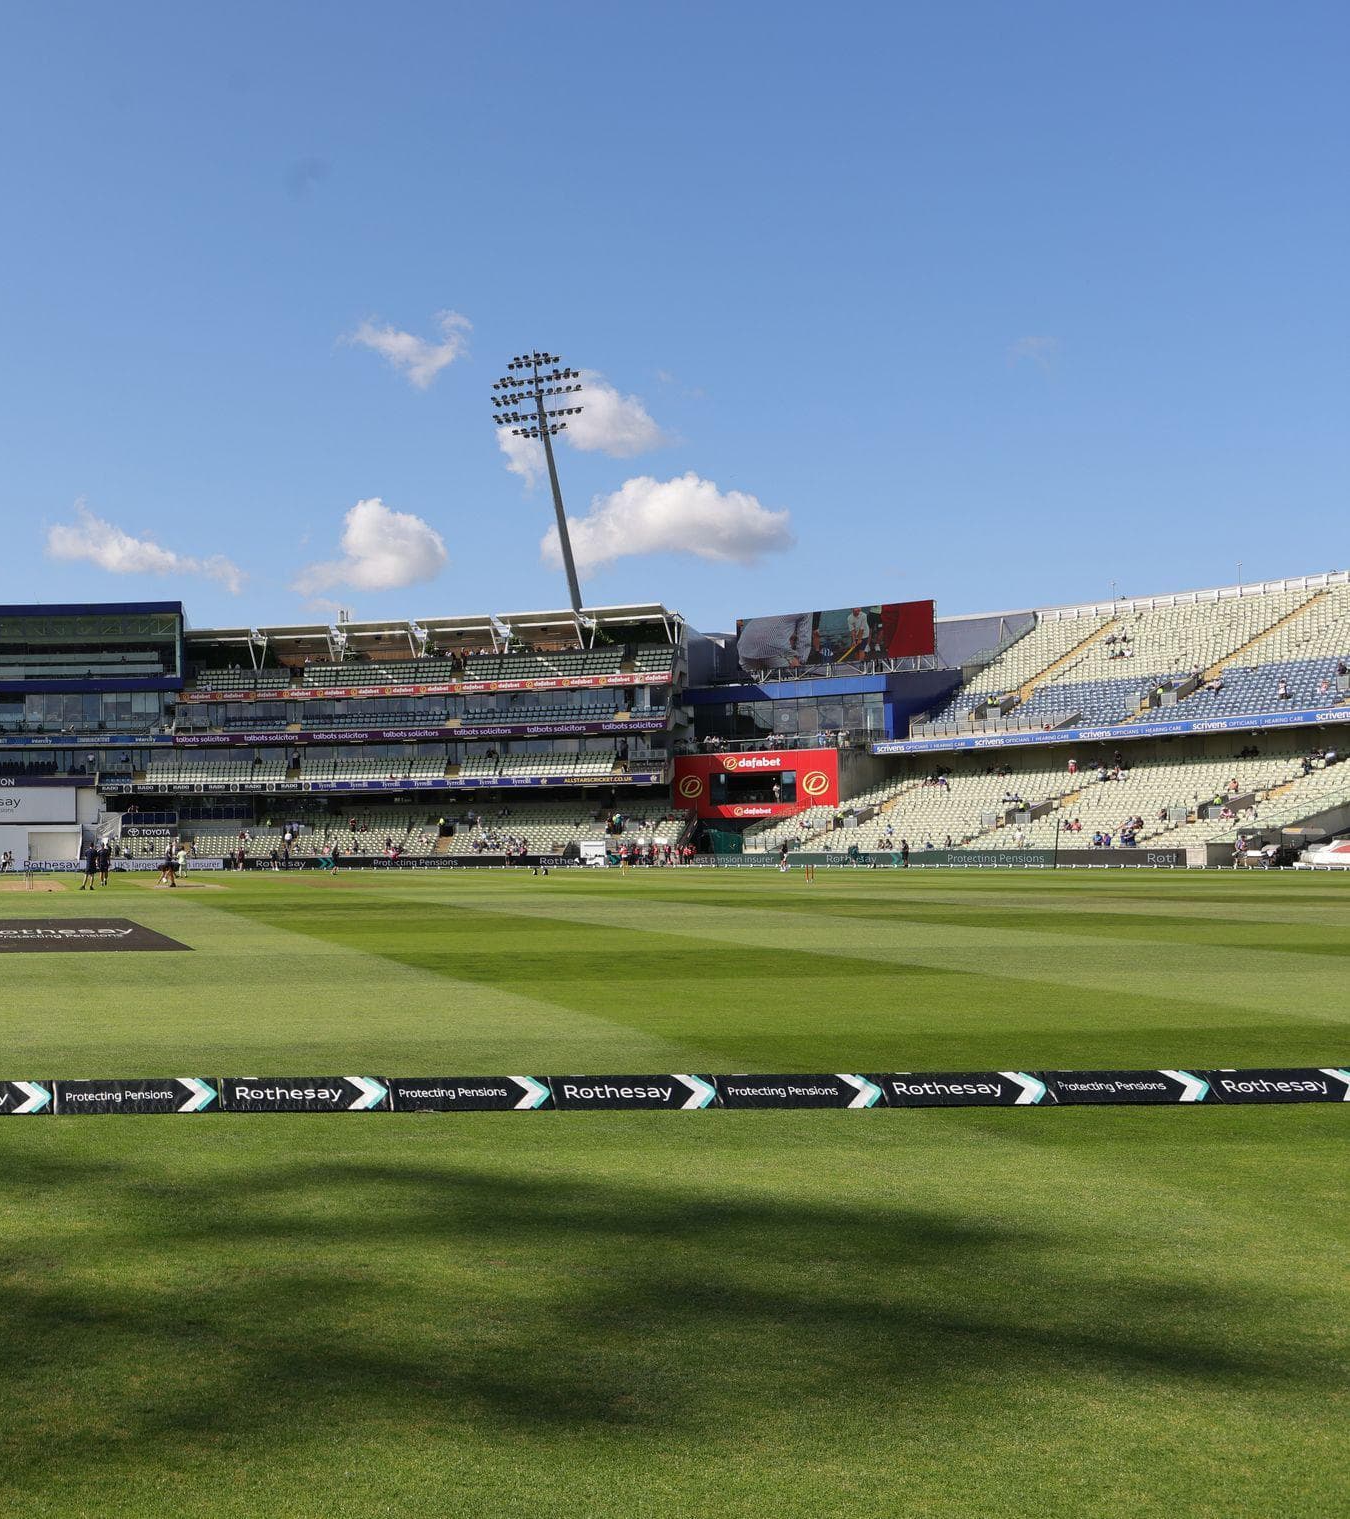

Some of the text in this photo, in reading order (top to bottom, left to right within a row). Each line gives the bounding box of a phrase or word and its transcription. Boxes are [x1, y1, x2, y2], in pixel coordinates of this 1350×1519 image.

[527, 725, 586, 733] talbots solicitors
[602, 721, 662, 730] talbots solicitors
[1192, 722, 1227, 730] scrivens
[1230, 719, 1258, 728] OPTICIANS
[313, 732, 368, 740] talbots solicitors
[383, 730, 439, 738] talbots solicitors
[454, 728, 511, 736] talbots solicitors
[1079, 730, 1110, 739] scrivens
[244, 734, 298, 742] talbots solicitors
[975, 738, 1004, 746] scrivens
[1005, 736, 1030, 744] OPTICIANS
[877, 744, 904, 752] scrivens
[738, 756, 781, 768] dafabet
[744, 856, 774, 864] insurer
[826, 855, 877, 864] Rothsay
[947, 853, 1044, 864] Protecting Pensions
[24, 860, 79, 870] Rothesay
[132, 860, 158, 869] largest
[892, 1081, 1001, 1097] Rothesay
[1057, 1080, 1166, 1092] Protecting Pensions
[1220, 1079, 1328, 1094] Rothesay
[66, 1090, 173, 1102] Protecting Pensions
[235, 1086, 342, 1100] Rothesay
[399, 1087, 507, 1099] Protecting Pensions
[563, 1084, 672, 1101] Rothesay
[728, 1086, 838, 1097] Protecting Pensions
